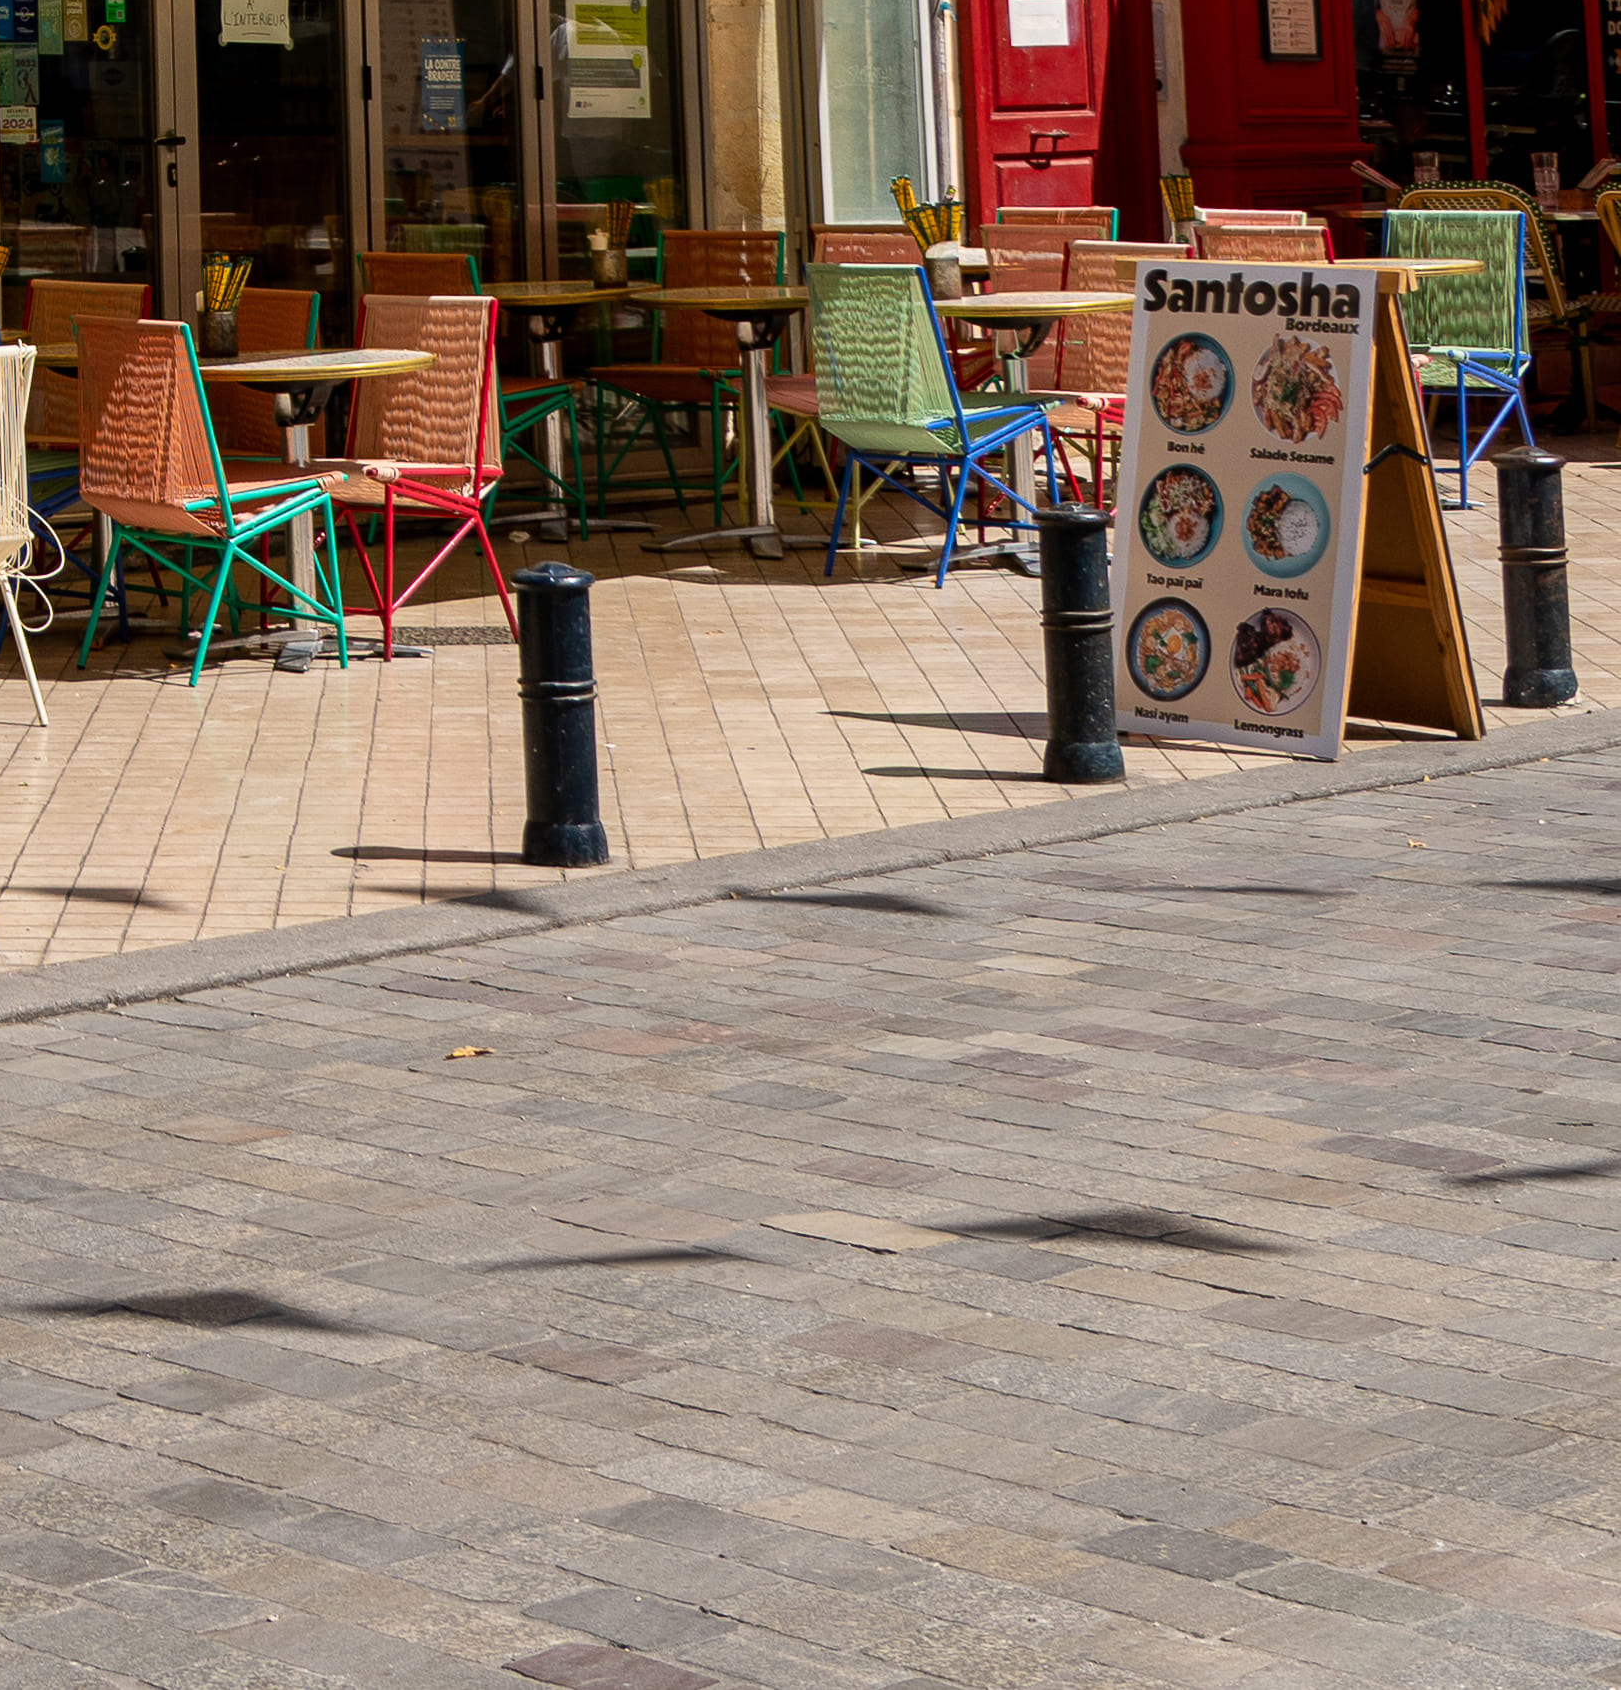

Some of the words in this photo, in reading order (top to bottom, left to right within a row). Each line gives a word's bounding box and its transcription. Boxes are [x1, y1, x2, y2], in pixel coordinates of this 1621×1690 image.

[2, 118, 34, 129] 2024
[1143, 268, 1361, 319] Santosha
[1285, 318, 1359, 335] Bordeaux
[1167, 441, 1188, 454] Bon
[1190, 442, 1206, 455] hé
[1249, 447, 1289, 462] Salade
[1290, 451, 1335, 465] Sesame
[1146, 573, 1165, 586] Tao
[1166, 575, 1184, 590] paï
[1184, 577, 1204, 591] paï
[1253, 584, 1283, 598] Mara
[1284, 586, 1310, 601] tofu
[1134, 706, 1158, 720] Nasi
[1159, 712, 1189, 724] ayam
[1234, 719, 1305, 739] Lemongrass
